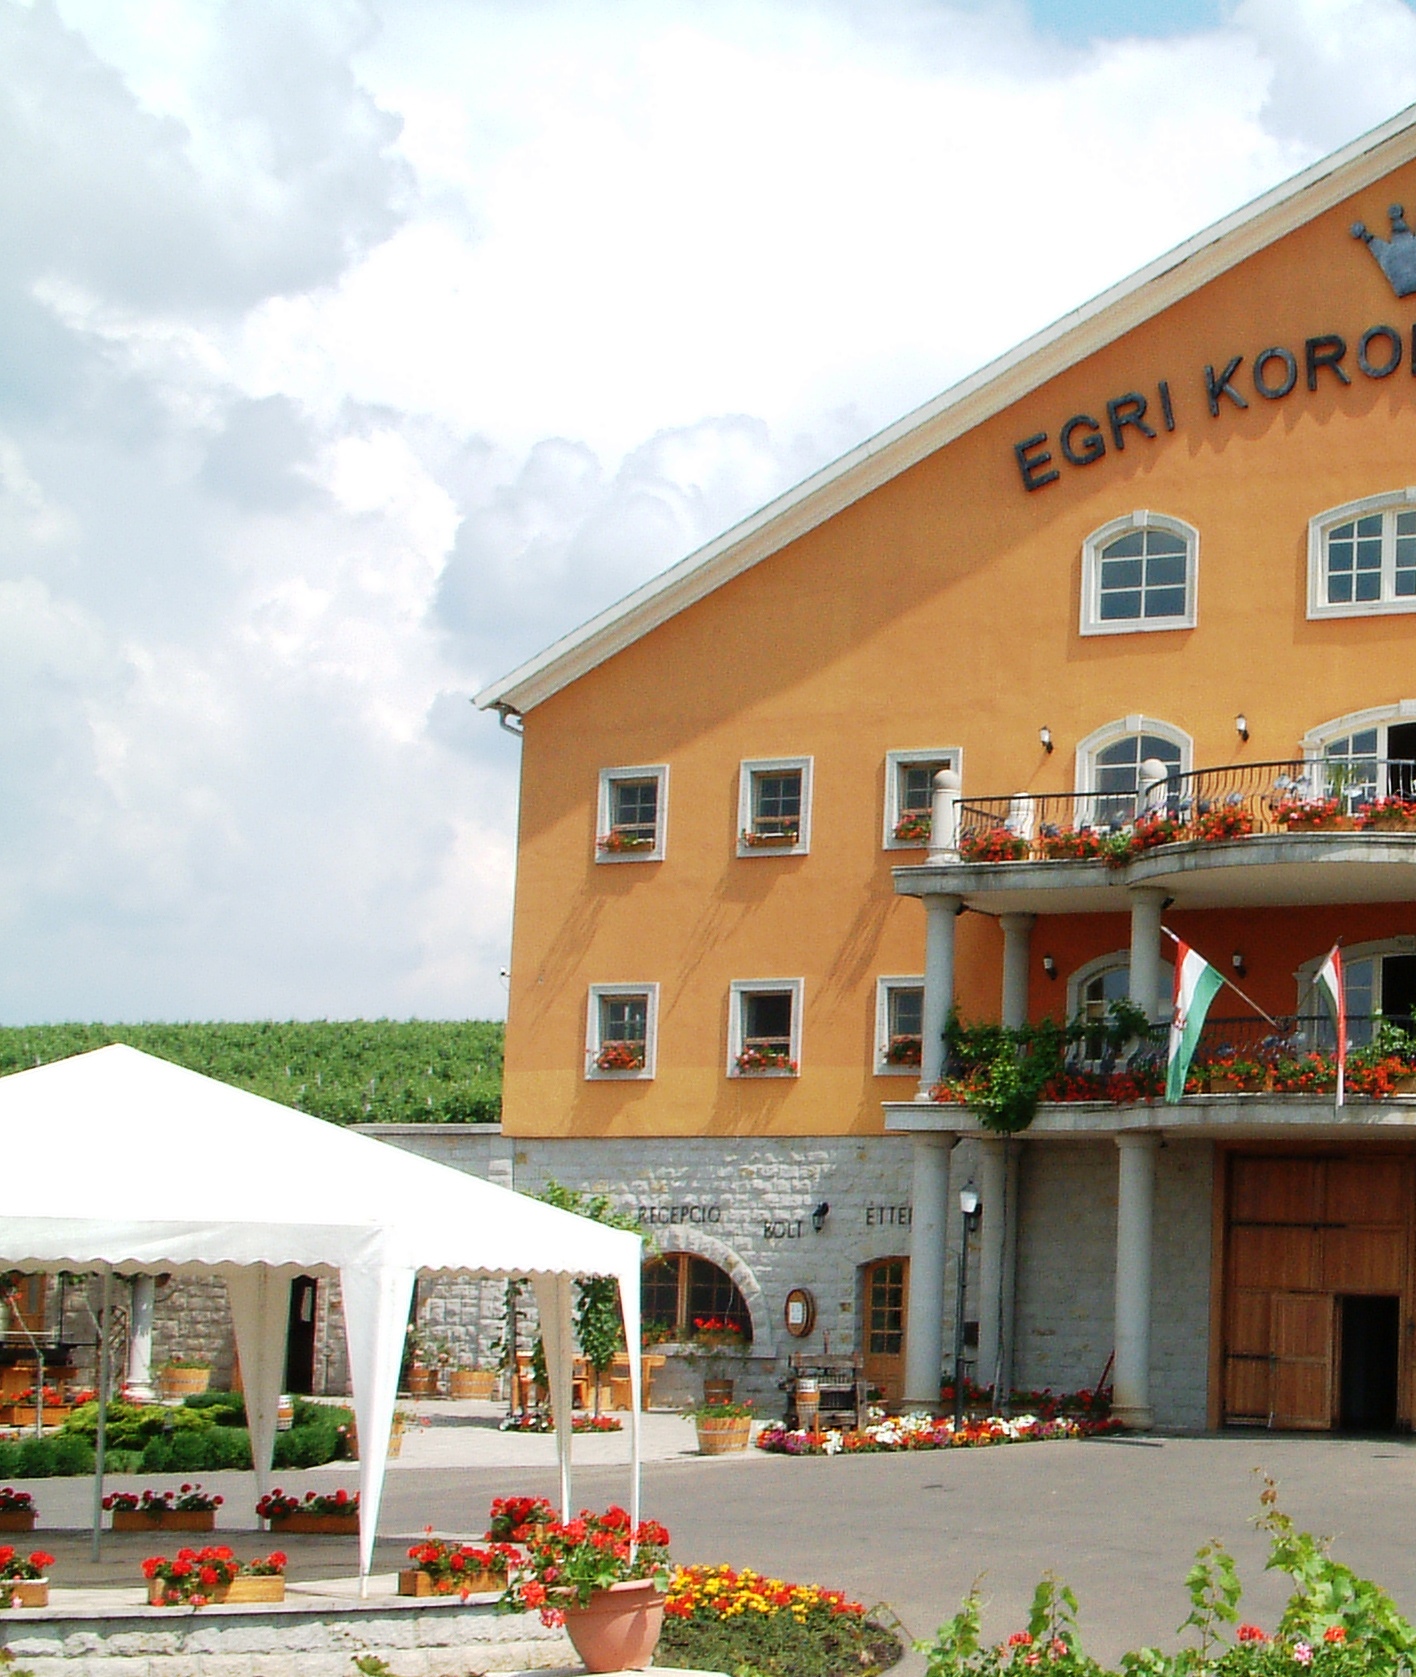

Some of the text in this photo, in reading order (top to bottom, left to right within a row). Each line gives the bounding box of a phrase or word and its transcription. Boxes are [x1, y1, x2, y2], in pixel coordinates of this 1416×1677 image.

[1013, 380, 1175, 492] EGRI
[866, 1201, 912, 1226] ÉTTE
[764, 1219, 803, 1239] BOLT
